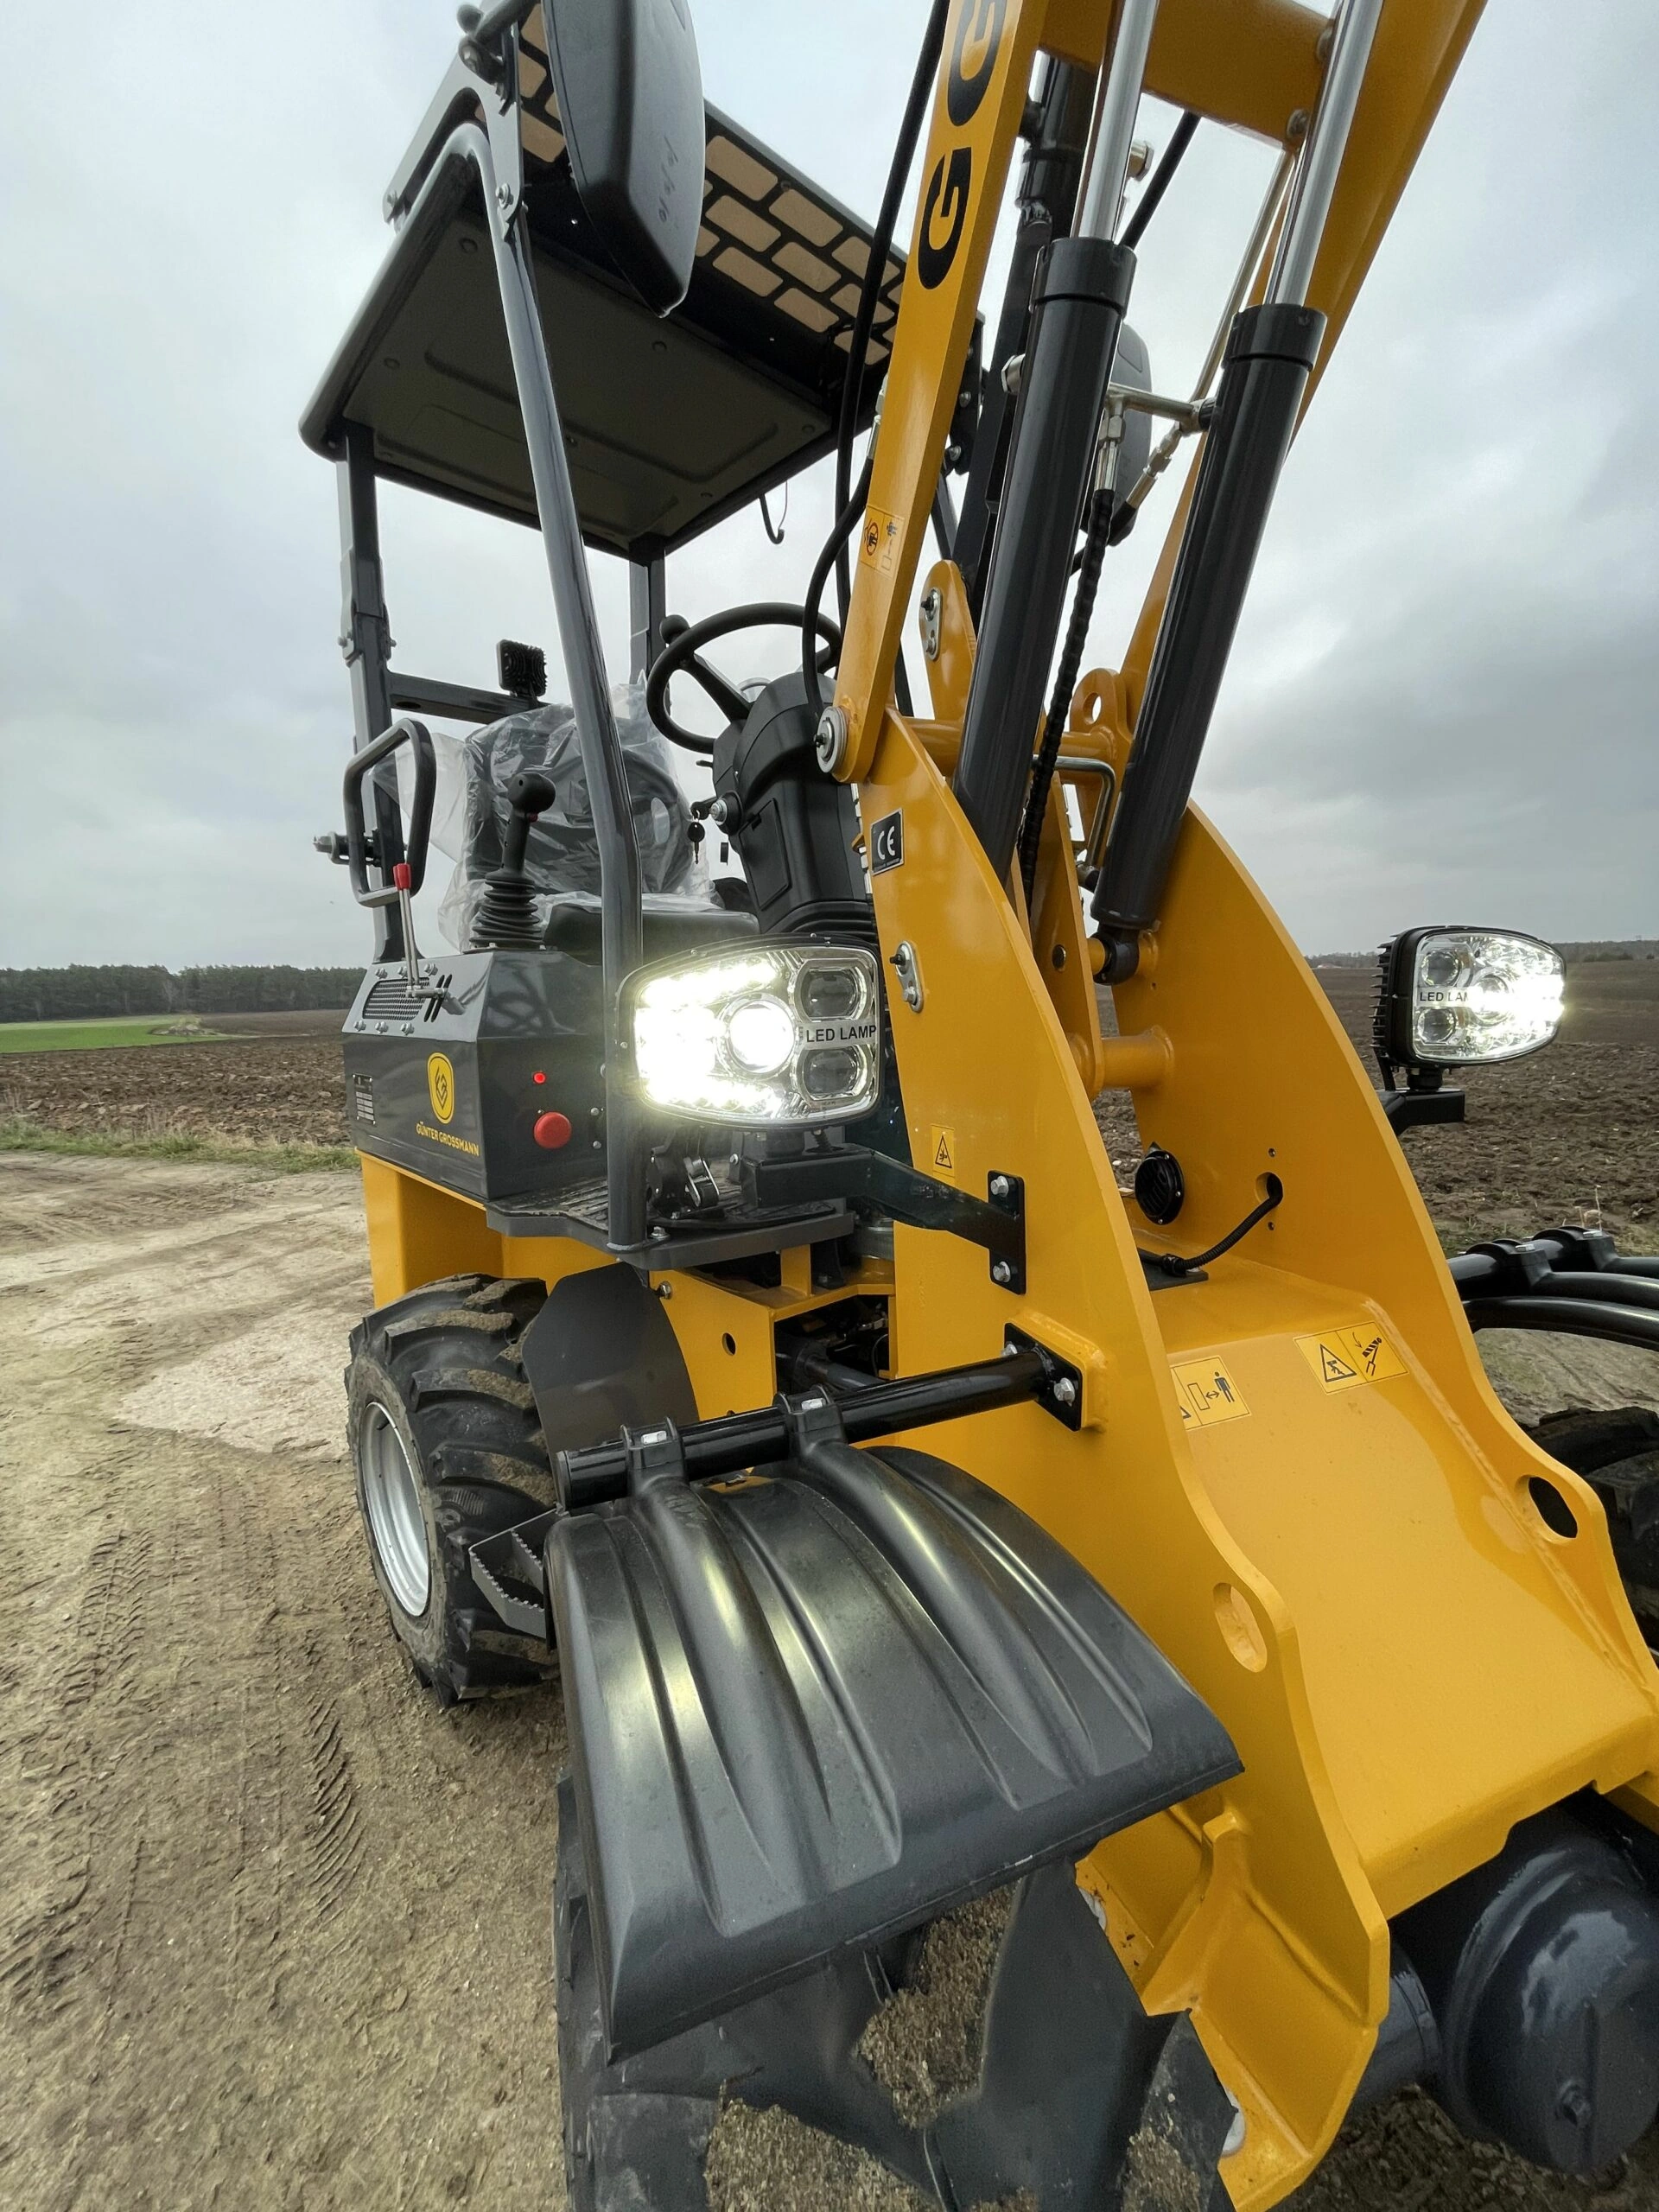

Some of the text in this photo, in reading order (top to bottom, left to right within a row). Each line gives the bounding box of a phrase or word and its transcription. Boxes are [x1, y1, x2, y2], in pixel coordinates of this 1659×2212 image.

[877, 826, 896, 861] CE
[1420, 992, 1444, 1002] LED
[806, 1025, 877, 1043] LED LAMP
[416, 1121, 480, 1157] GÜNTER GROSSMANN
